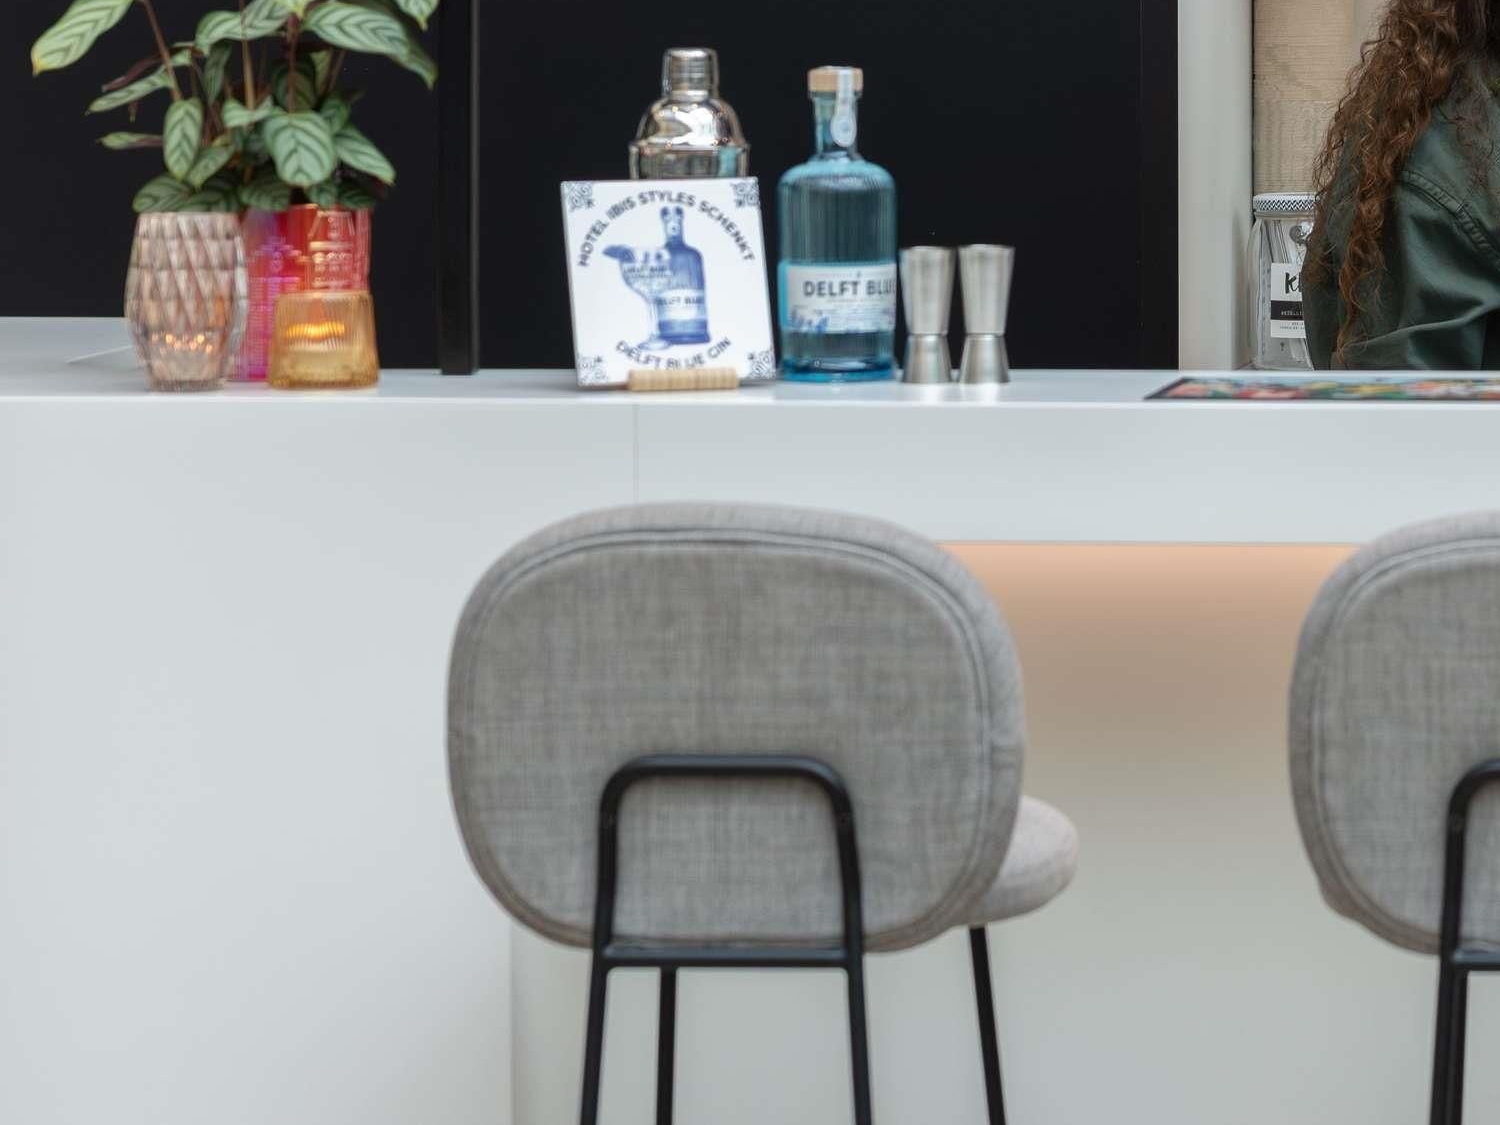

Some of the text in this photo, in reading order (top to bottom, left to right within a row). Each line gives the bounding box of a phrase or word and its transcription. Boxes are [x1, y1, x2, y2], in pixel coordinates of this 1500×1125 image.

[577, 190, 755, 267] HOTEL IBIS STYLES SCHENKT
[803, 280, 860, 296] DELFT
[616, 340, 662, 369] DELFT
[707, 337, 731, 359] GIN
